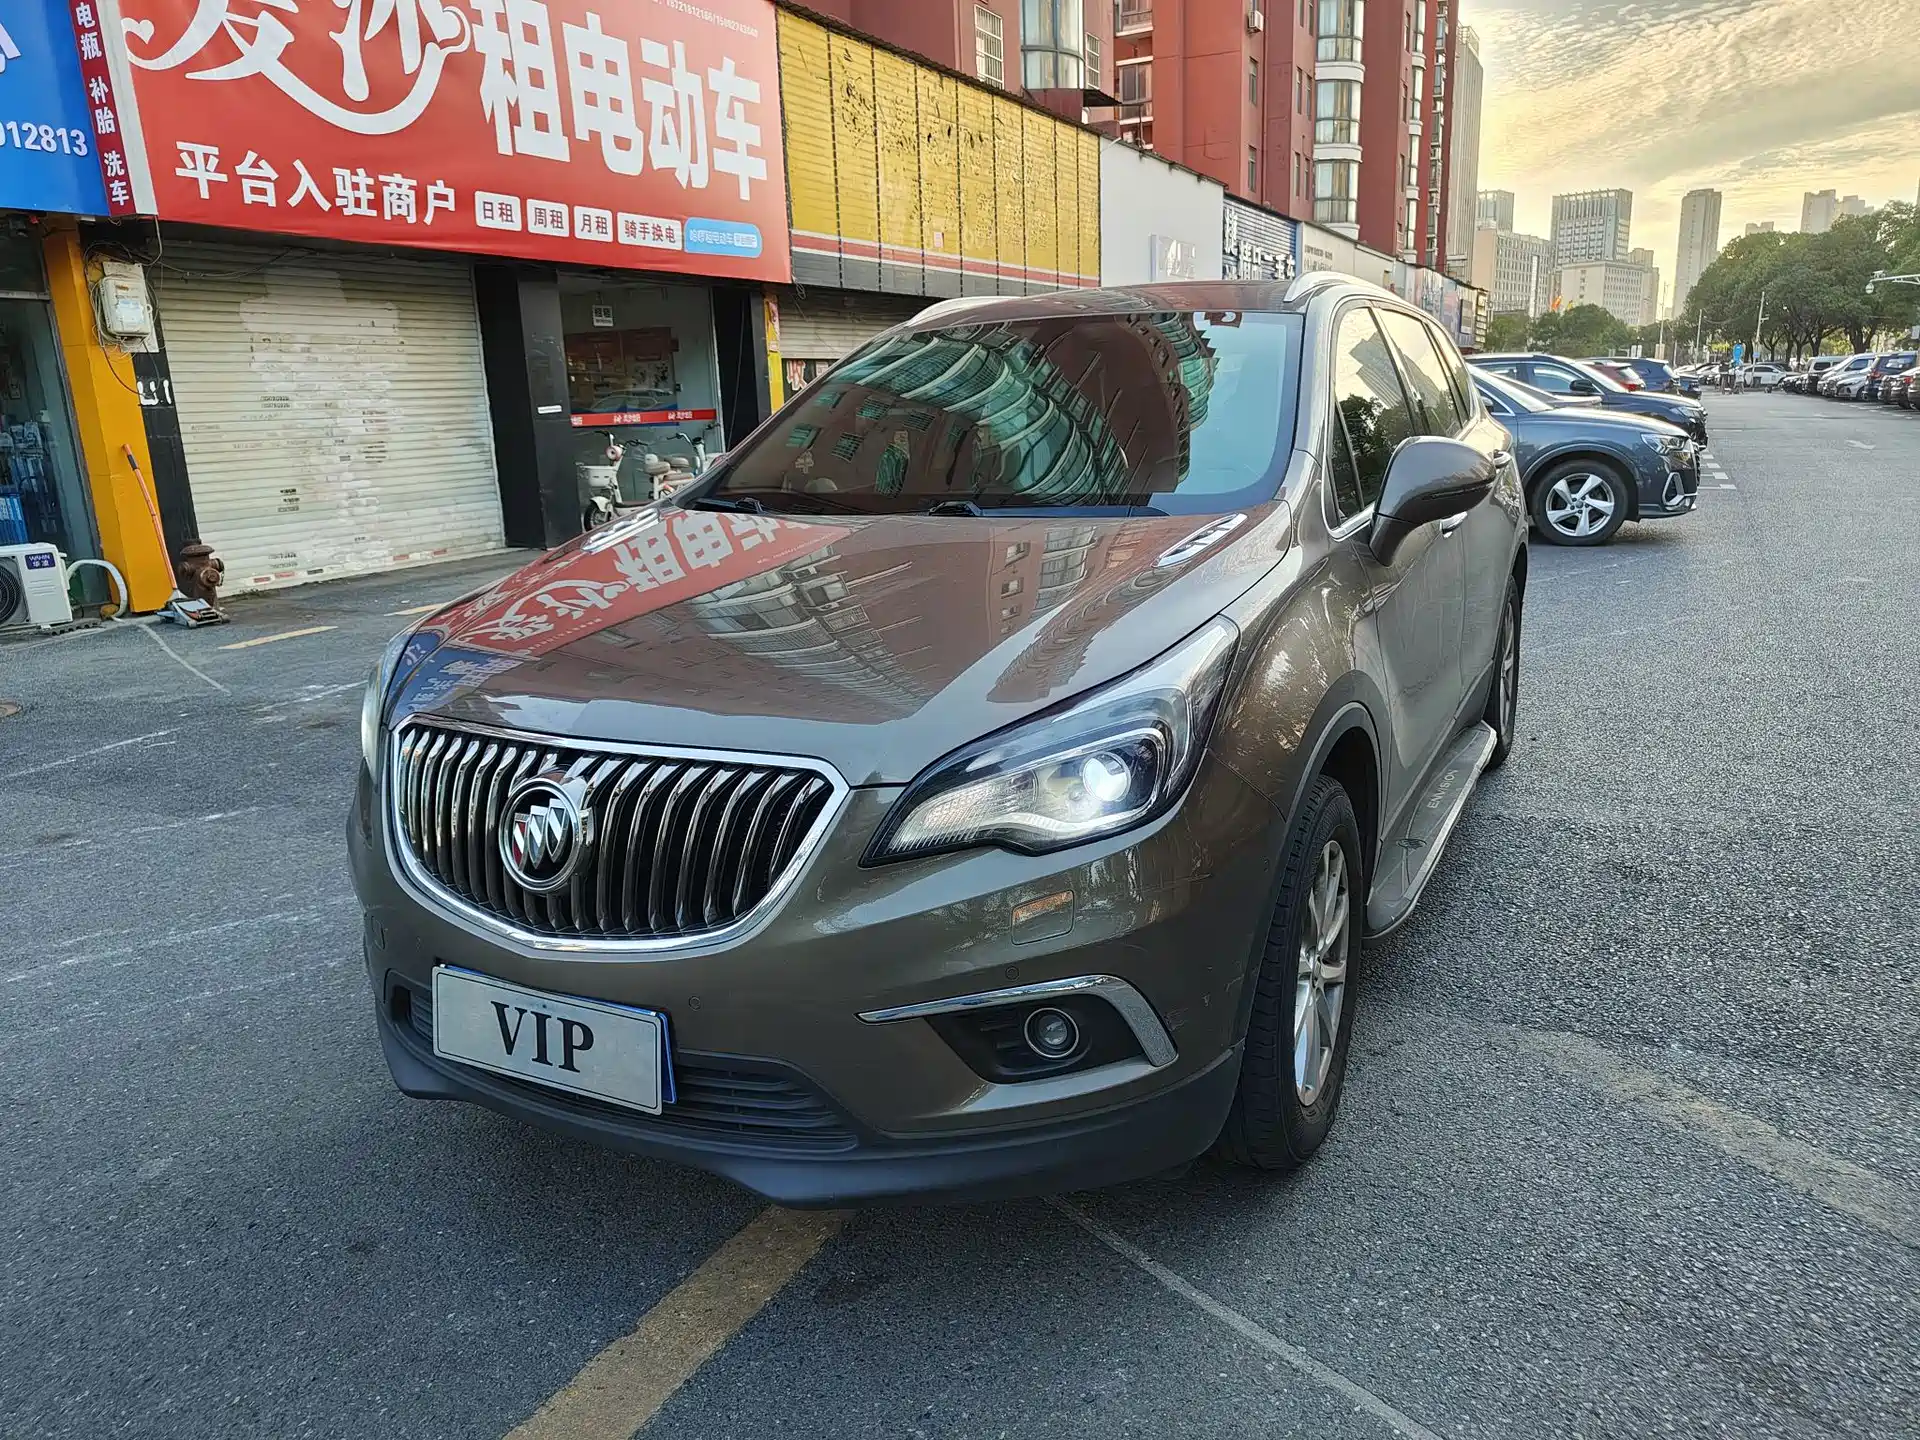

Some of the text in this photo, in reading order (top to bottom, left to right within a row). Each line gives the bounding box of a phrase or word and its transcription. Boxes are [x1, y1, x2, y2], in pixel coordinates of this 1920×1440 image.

[76, 2, 130, 206] 电瓶 补胎 洗车
[174, 140, 458, 226] 平台入驻商户
[482, 201, 515, 224] 日租
[533, 206, 565, 230] 周租
[580, 213, 609, 236] 月租
[624, 219, 676, 244] 骑手换电
[490, 1000, 595, 1073] VIP
